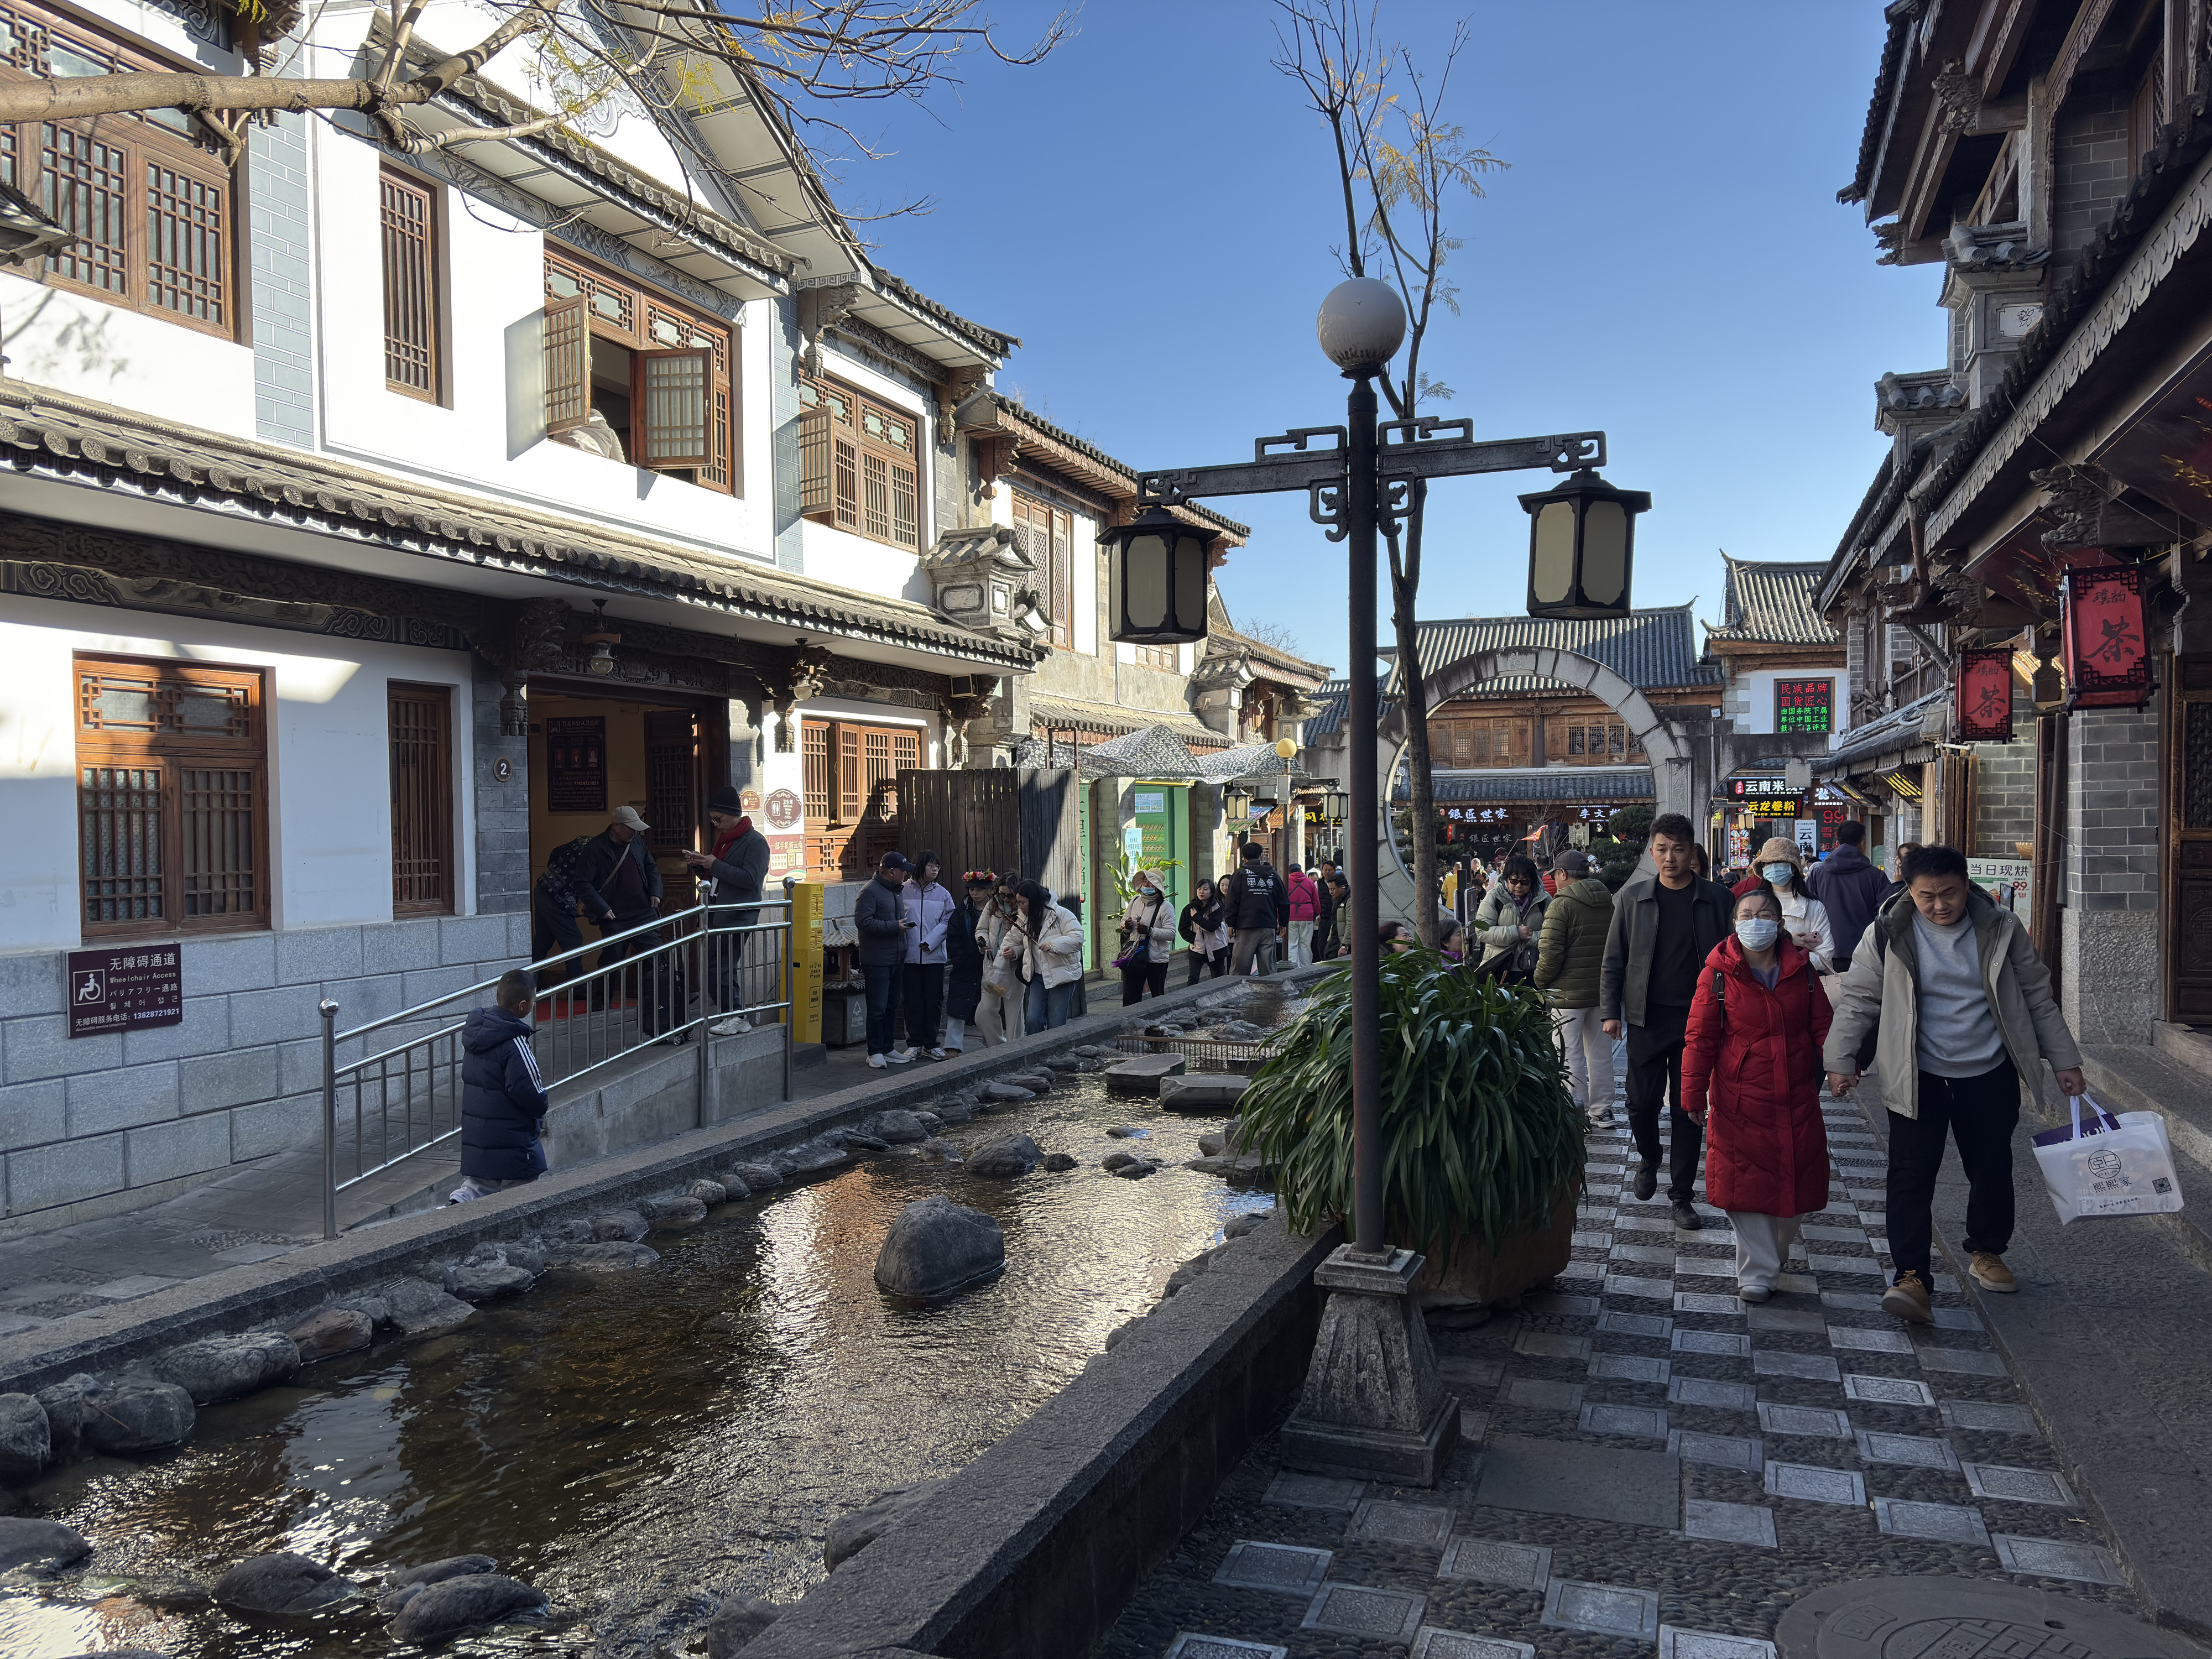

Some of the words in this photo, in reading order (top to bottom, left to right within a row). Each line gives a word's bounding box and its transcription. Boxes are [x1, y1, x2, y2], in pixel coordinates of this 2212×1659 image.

[2084, 616, 2140, 662] 茶
[1781, 682, 1827, 695] 民族品牌
[1781, 696, 1828, 707] 国货匠心
[1966, 685, 2006, 718] 茶
[1781, 715, 1828, 723] 单位中国工业
[500, 763, 507, 775] 2
[1748, 800, 1795, 811] 云龙卷粉
[1823, 810, 1848, 823] 99
[770, 841, 803, 850] 一部手机游云南
[1970, 863, 2028, 877] 当日现烘
[2013, 881, 2027, 891] 9.9
[110, 952, 175, 971] 无障碍通道
[109, 974, 149, 984] Wheelchair
[109, 983, 178, 997] バリアフリー通路
[133, 1008, 179, 1019] 13628721921
[2093, 1176, 2132, 1193] 熙熙家
